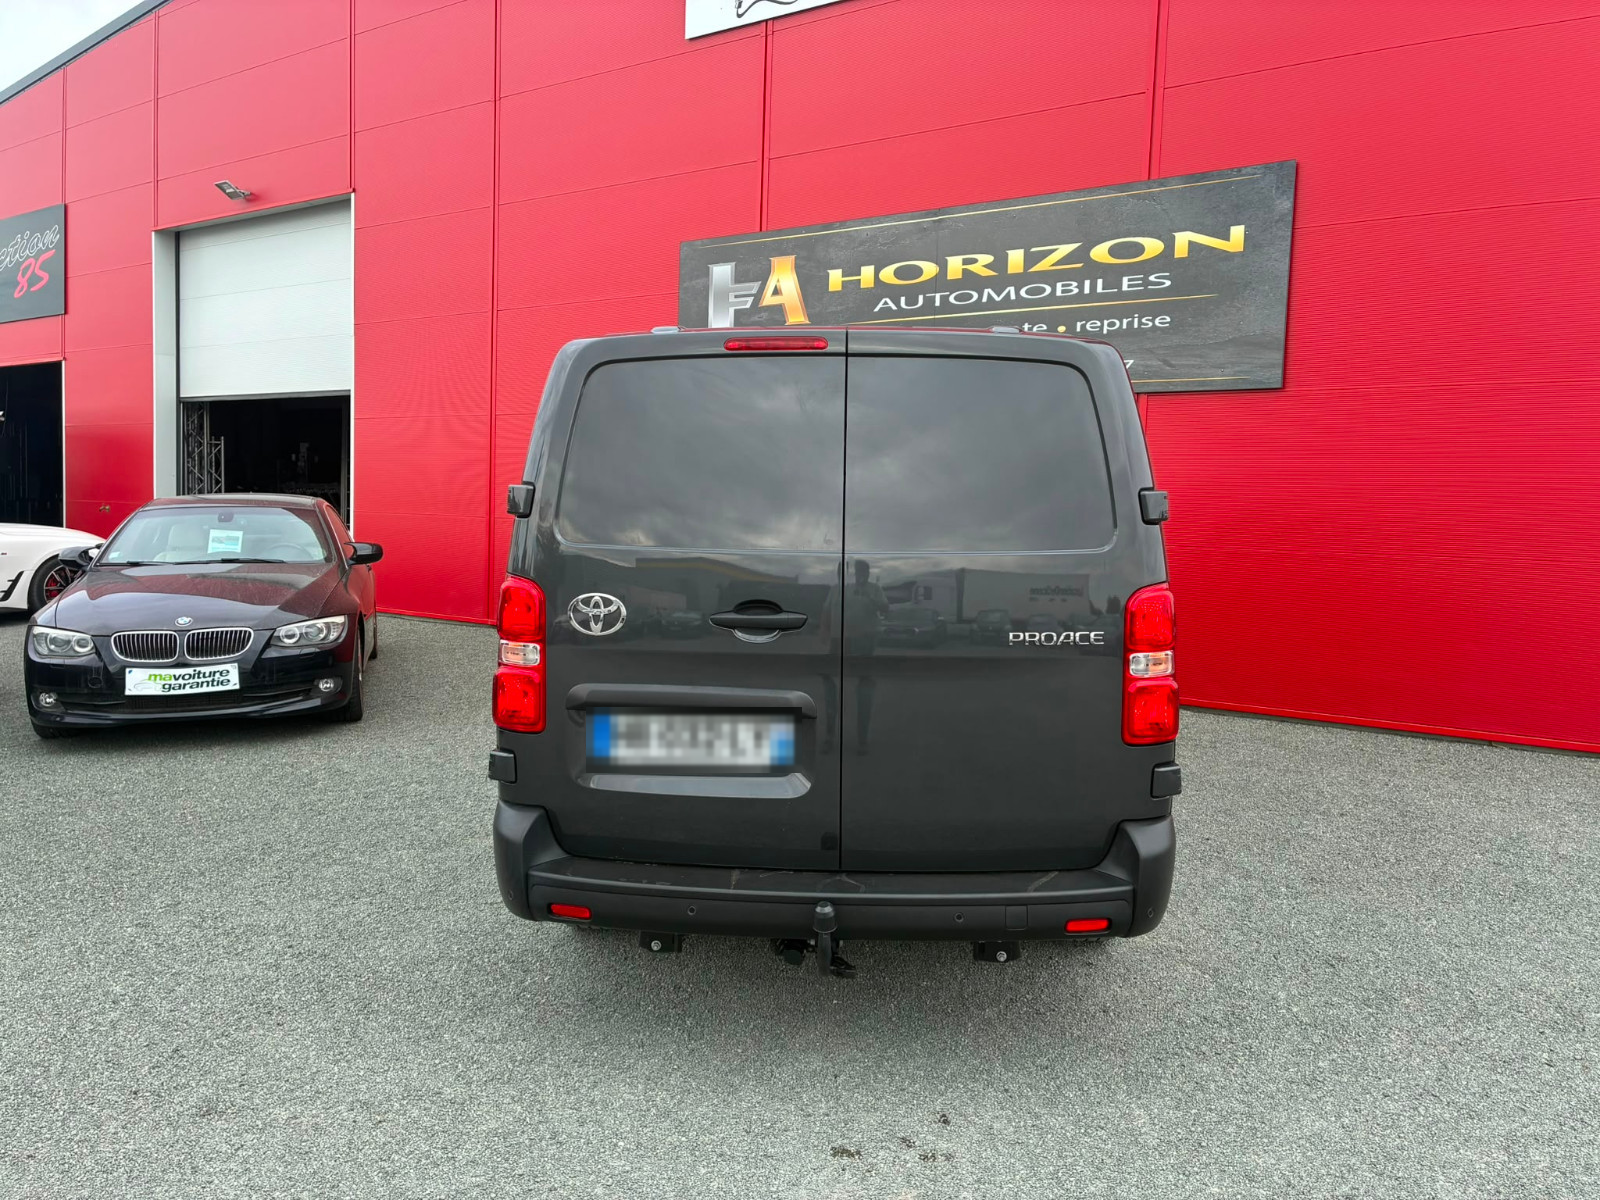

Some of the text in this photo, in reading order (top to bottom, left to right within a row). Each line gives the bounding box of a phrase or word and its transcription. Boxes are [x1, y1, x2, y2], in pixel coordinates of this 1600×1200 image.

[827, 225, 1246, 292] HORIZON
[13, 249, 56, 299] 85
[873, 273, 1172, 312] AUTOMOBILES
[1076, 314, 1171, 335] reprise
[1008, 631, 1105, 646] PROACE
[161, 677, 231, 693] garantie
